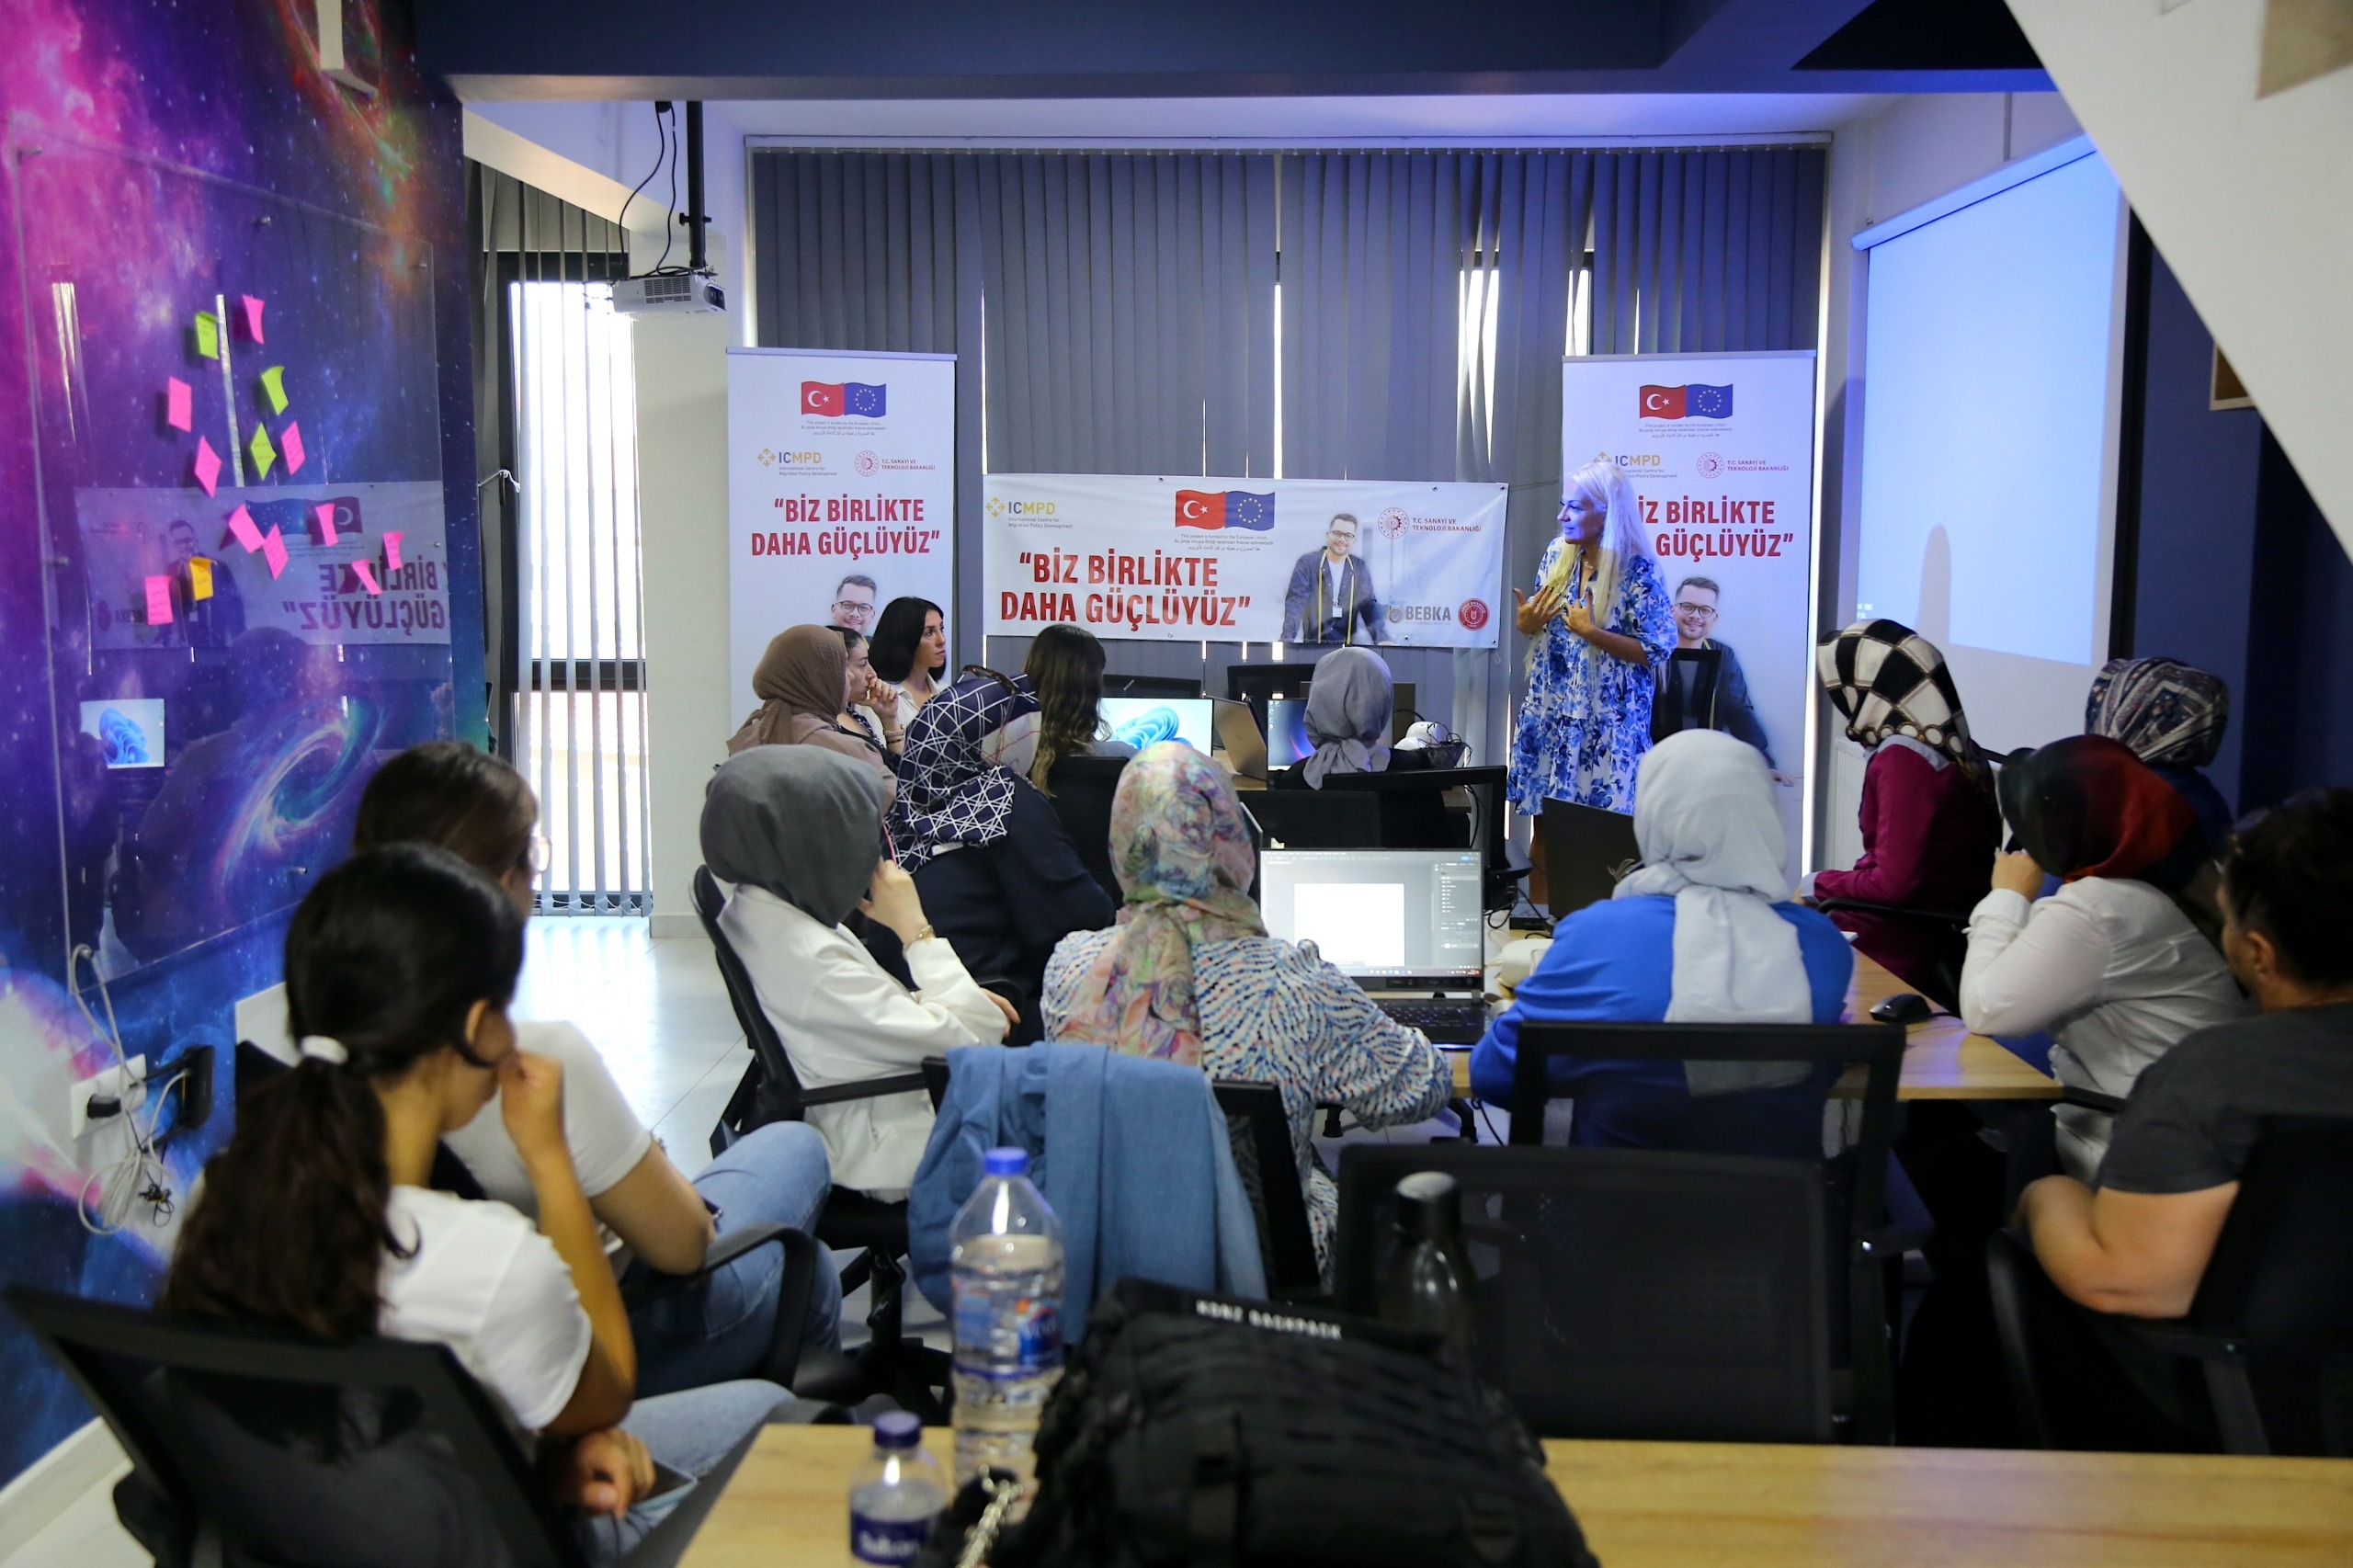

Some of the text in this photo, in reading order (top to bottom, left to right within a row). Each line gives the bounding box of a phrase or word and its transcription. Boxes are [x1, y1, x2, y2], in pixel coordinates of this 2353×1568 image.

[779, 451, 822, 463] ICMPD
[1615, 455, 1661, 467] ICMPD
[827, 494, 924, 522] BİRLİKTE
[1008, 502, 1056, 515] ICMPD
[1638, 495, 1775, 524] İZ BİRLİKTE
[752, 532, 812, 555] DAHA
[1088, 548, 1218, 587] BİRLİKTE
[1001, 591, 1076, 622] DAHA
[1405, 606, 1451, 621] BEBKA
